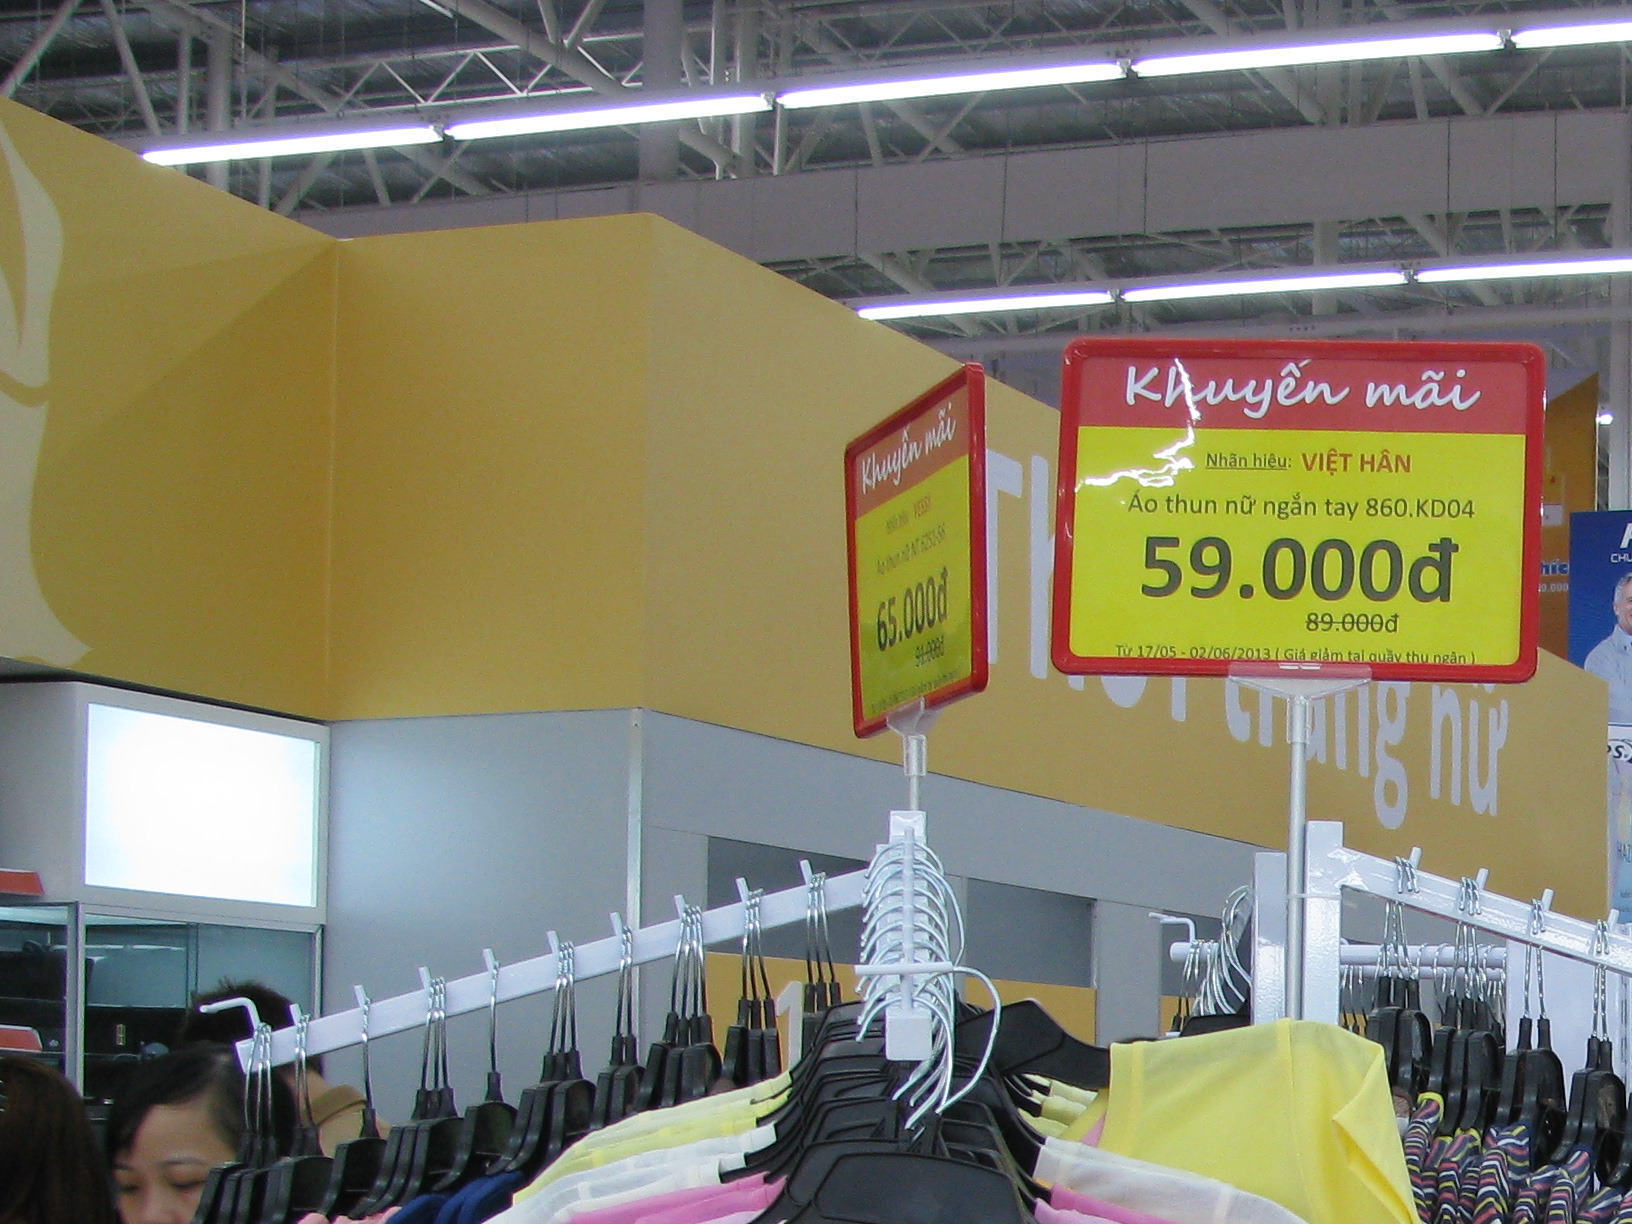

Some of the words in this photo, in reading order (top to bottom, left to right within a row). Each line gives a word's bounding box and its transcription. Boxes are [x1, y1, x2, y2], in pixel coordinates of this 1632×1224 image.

[1125, 359, 1350, 419] Khuyến
[1365, 368, 1482, 411] mãi
[862, 423, 923, 495] Khuyến
[925, 402, 956, 455] mãi
[1206, 453, 1248, 469] Nhãn
[1301, 448, 1353, 476] VIỆT
[1359, 449, 1412, 473] HÂN
[1127, 489, 1158, 514] Áo
[1166, 494, 1217, 514] thun
[1225, 495, 1257, 515] nữ
[1264, 491, 1317, 520] ngắn
[1325, 501, 1359, 521] tay
[1365, 498, 1475, 519] 860.KD04
[1141, 536, 1459, 602] 59.000đ
[878, 566, 948, 652] 65.000đ
[1306, 612, 1399, 633] 89.000đ
[1138, 645, 1177, 658] 17/05
[1190, 646, 1271, 660] 02/06/2013
